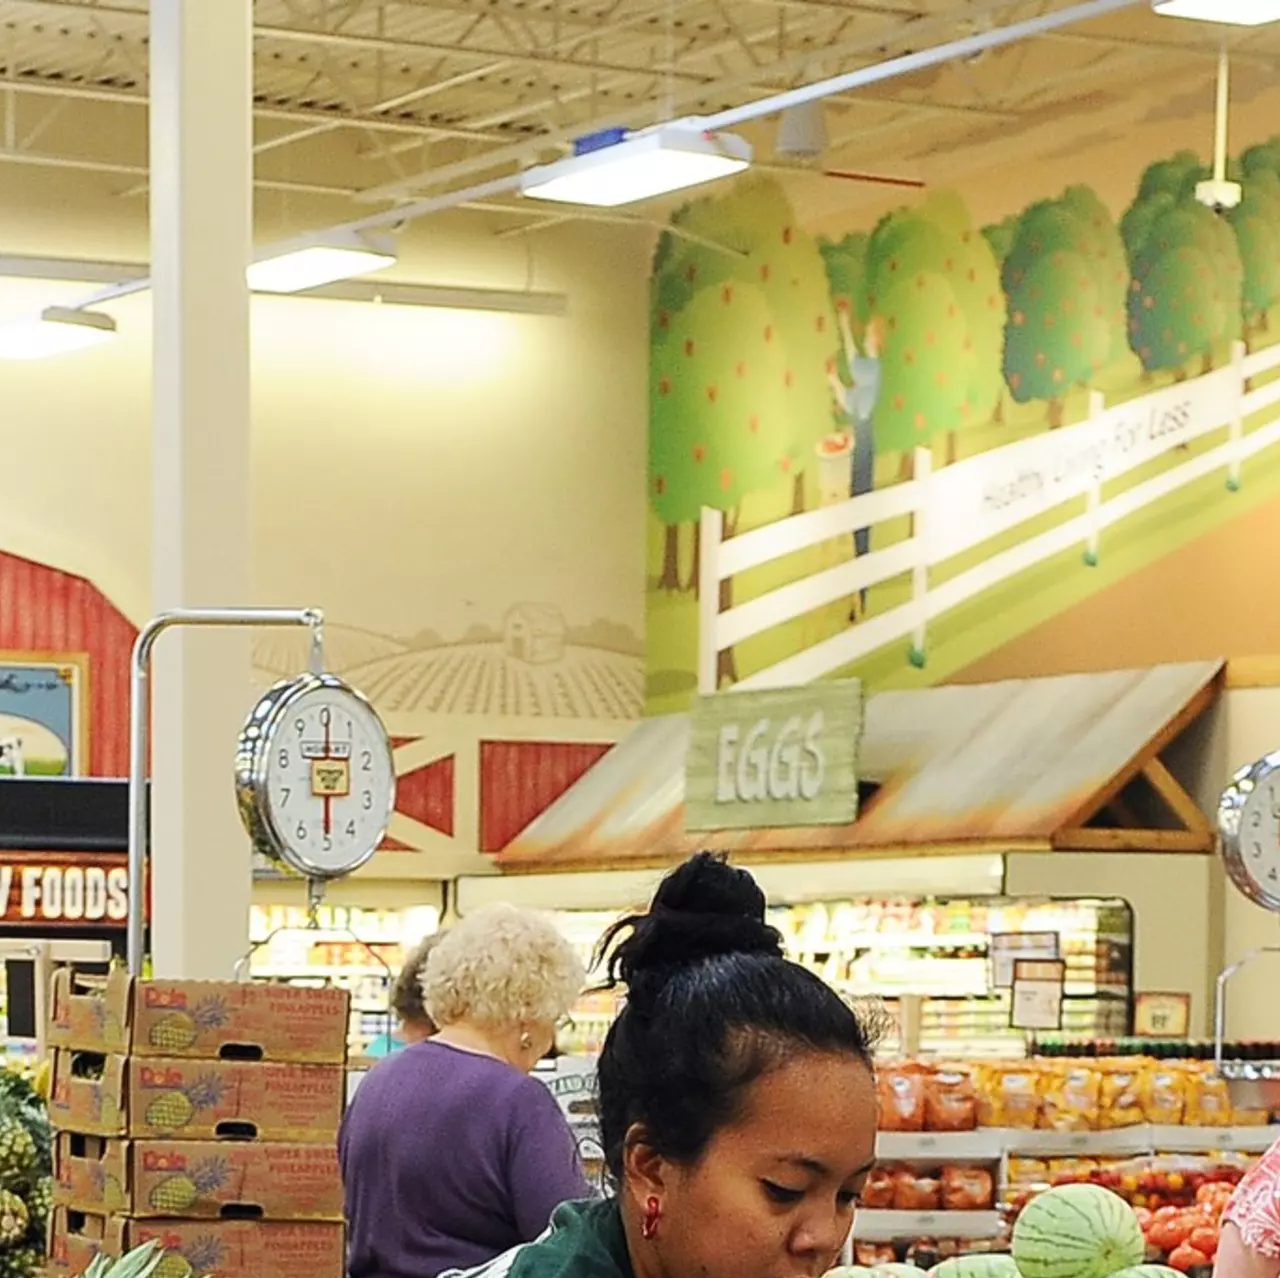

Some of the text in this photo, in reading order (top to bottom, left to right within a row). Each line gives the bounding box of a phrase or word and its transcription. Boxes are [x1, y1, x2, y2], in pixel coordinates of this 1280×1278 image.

[278, 749, 289, 769] 8
[361, 751, 372, 772] 2
[714, 711, 825, 804] EGGS
[280, 787, 292, 809] 7
[362, 790, 373, 811] 3
[296, 820, 308, 840] 6
[345, 819, 357, 839] 4
[21, 865, 129, 920] FOODS
[144, 986, 188, 1008] Dole
[140, 1066, 183, 1087] Dole
[142, 1150, 190, 1171] Dole
